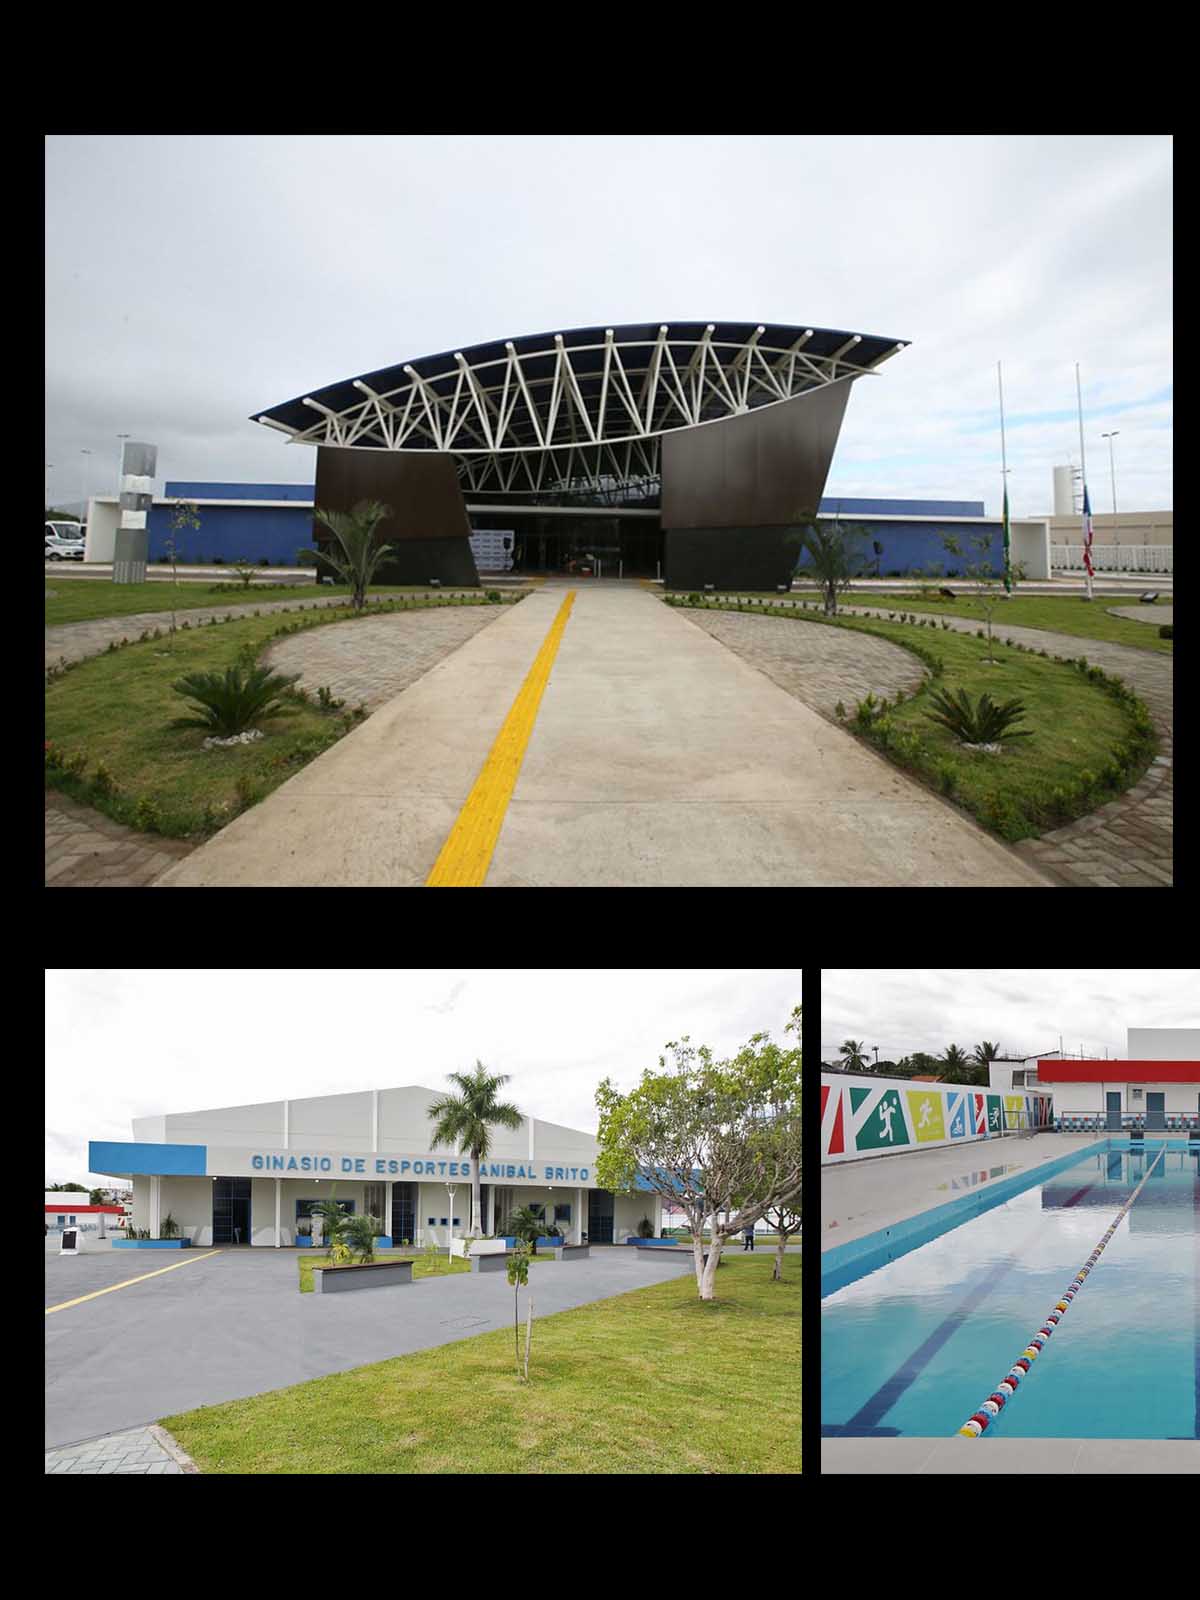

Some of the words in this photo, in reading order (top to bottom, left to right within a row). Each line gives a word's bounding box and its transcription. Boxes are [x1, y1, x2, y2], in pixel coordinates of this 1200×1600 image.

[252, 1155, 332, 1171] GINASIO
[342, 1158, 366, 1173] DE
[375, 1159, 471, 1176] ESPORTES
[480, 1163, 537, 1179] ANIBAL
[545, 1166, 589, 1181] BRITO
